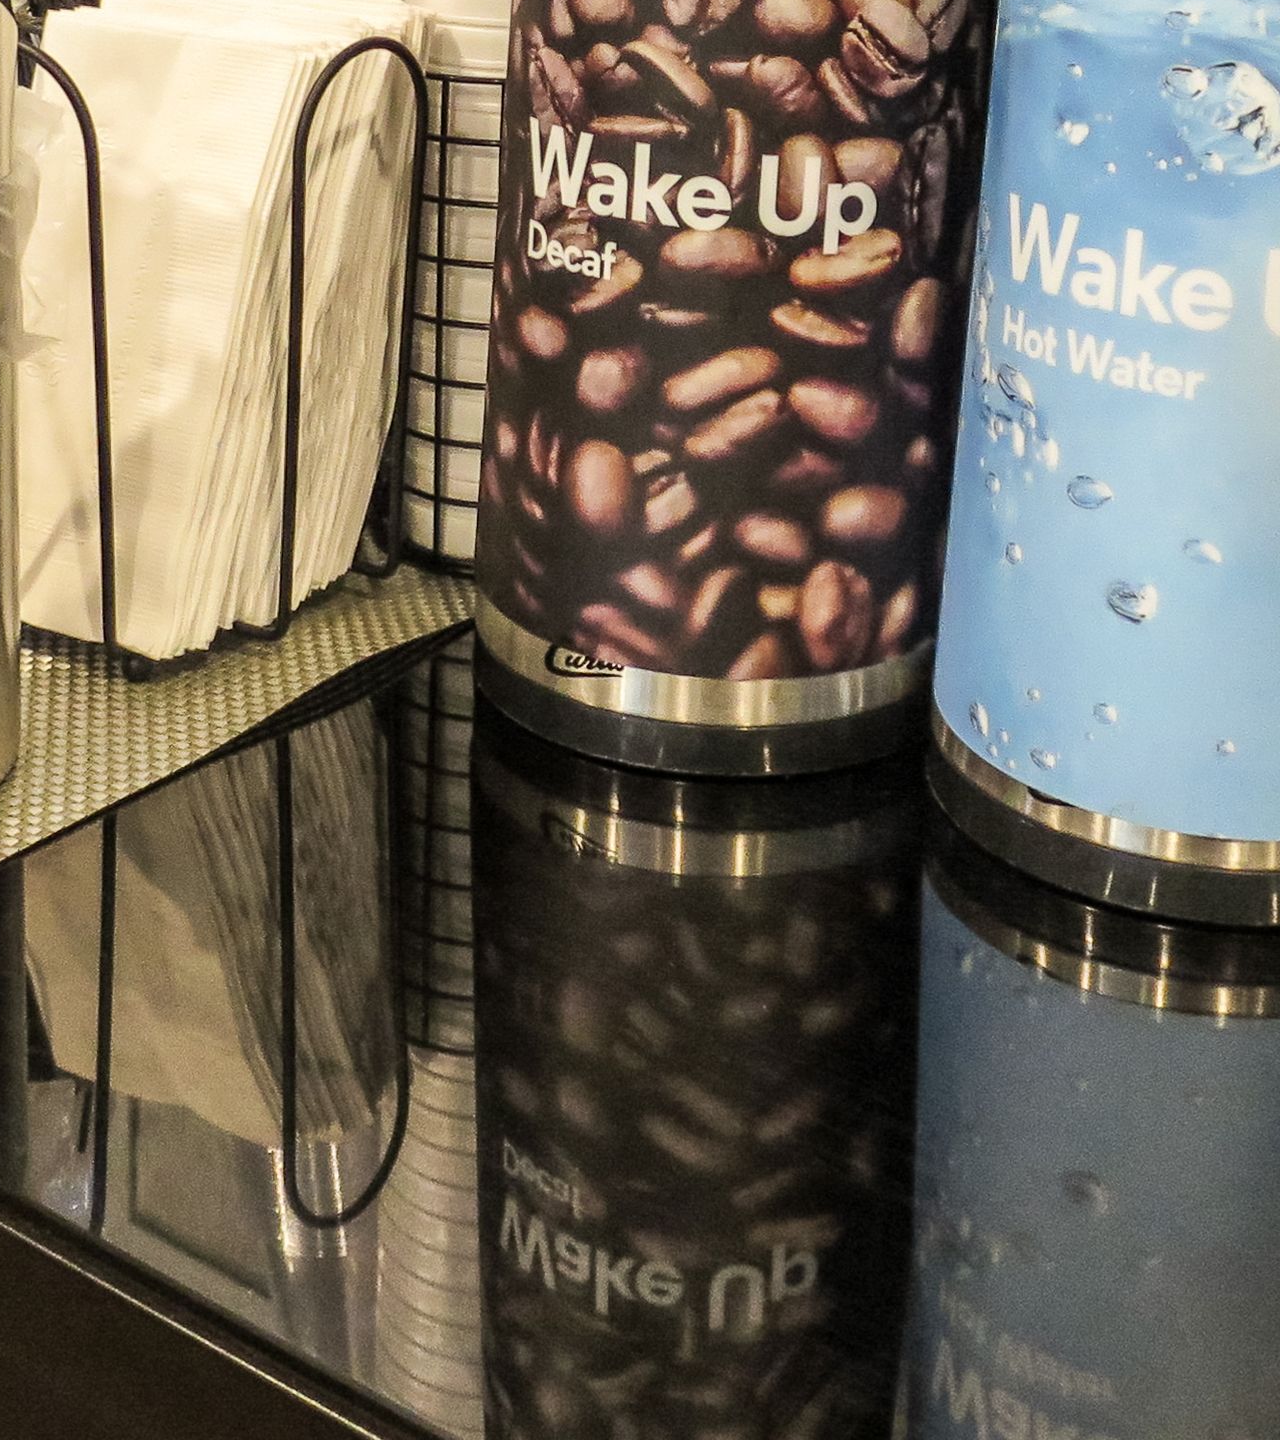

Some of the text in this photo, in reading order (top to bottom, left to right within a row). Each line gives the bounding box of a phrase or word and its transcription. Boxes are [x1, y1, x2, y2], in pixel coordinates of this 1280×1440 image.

[528, 115, 878, 256] Wake Up
[527, 218, 619, 281] Decaf
[1007, 192, 1234, 332] Wake
[1001, 304, 1207, 401] Hot Water
